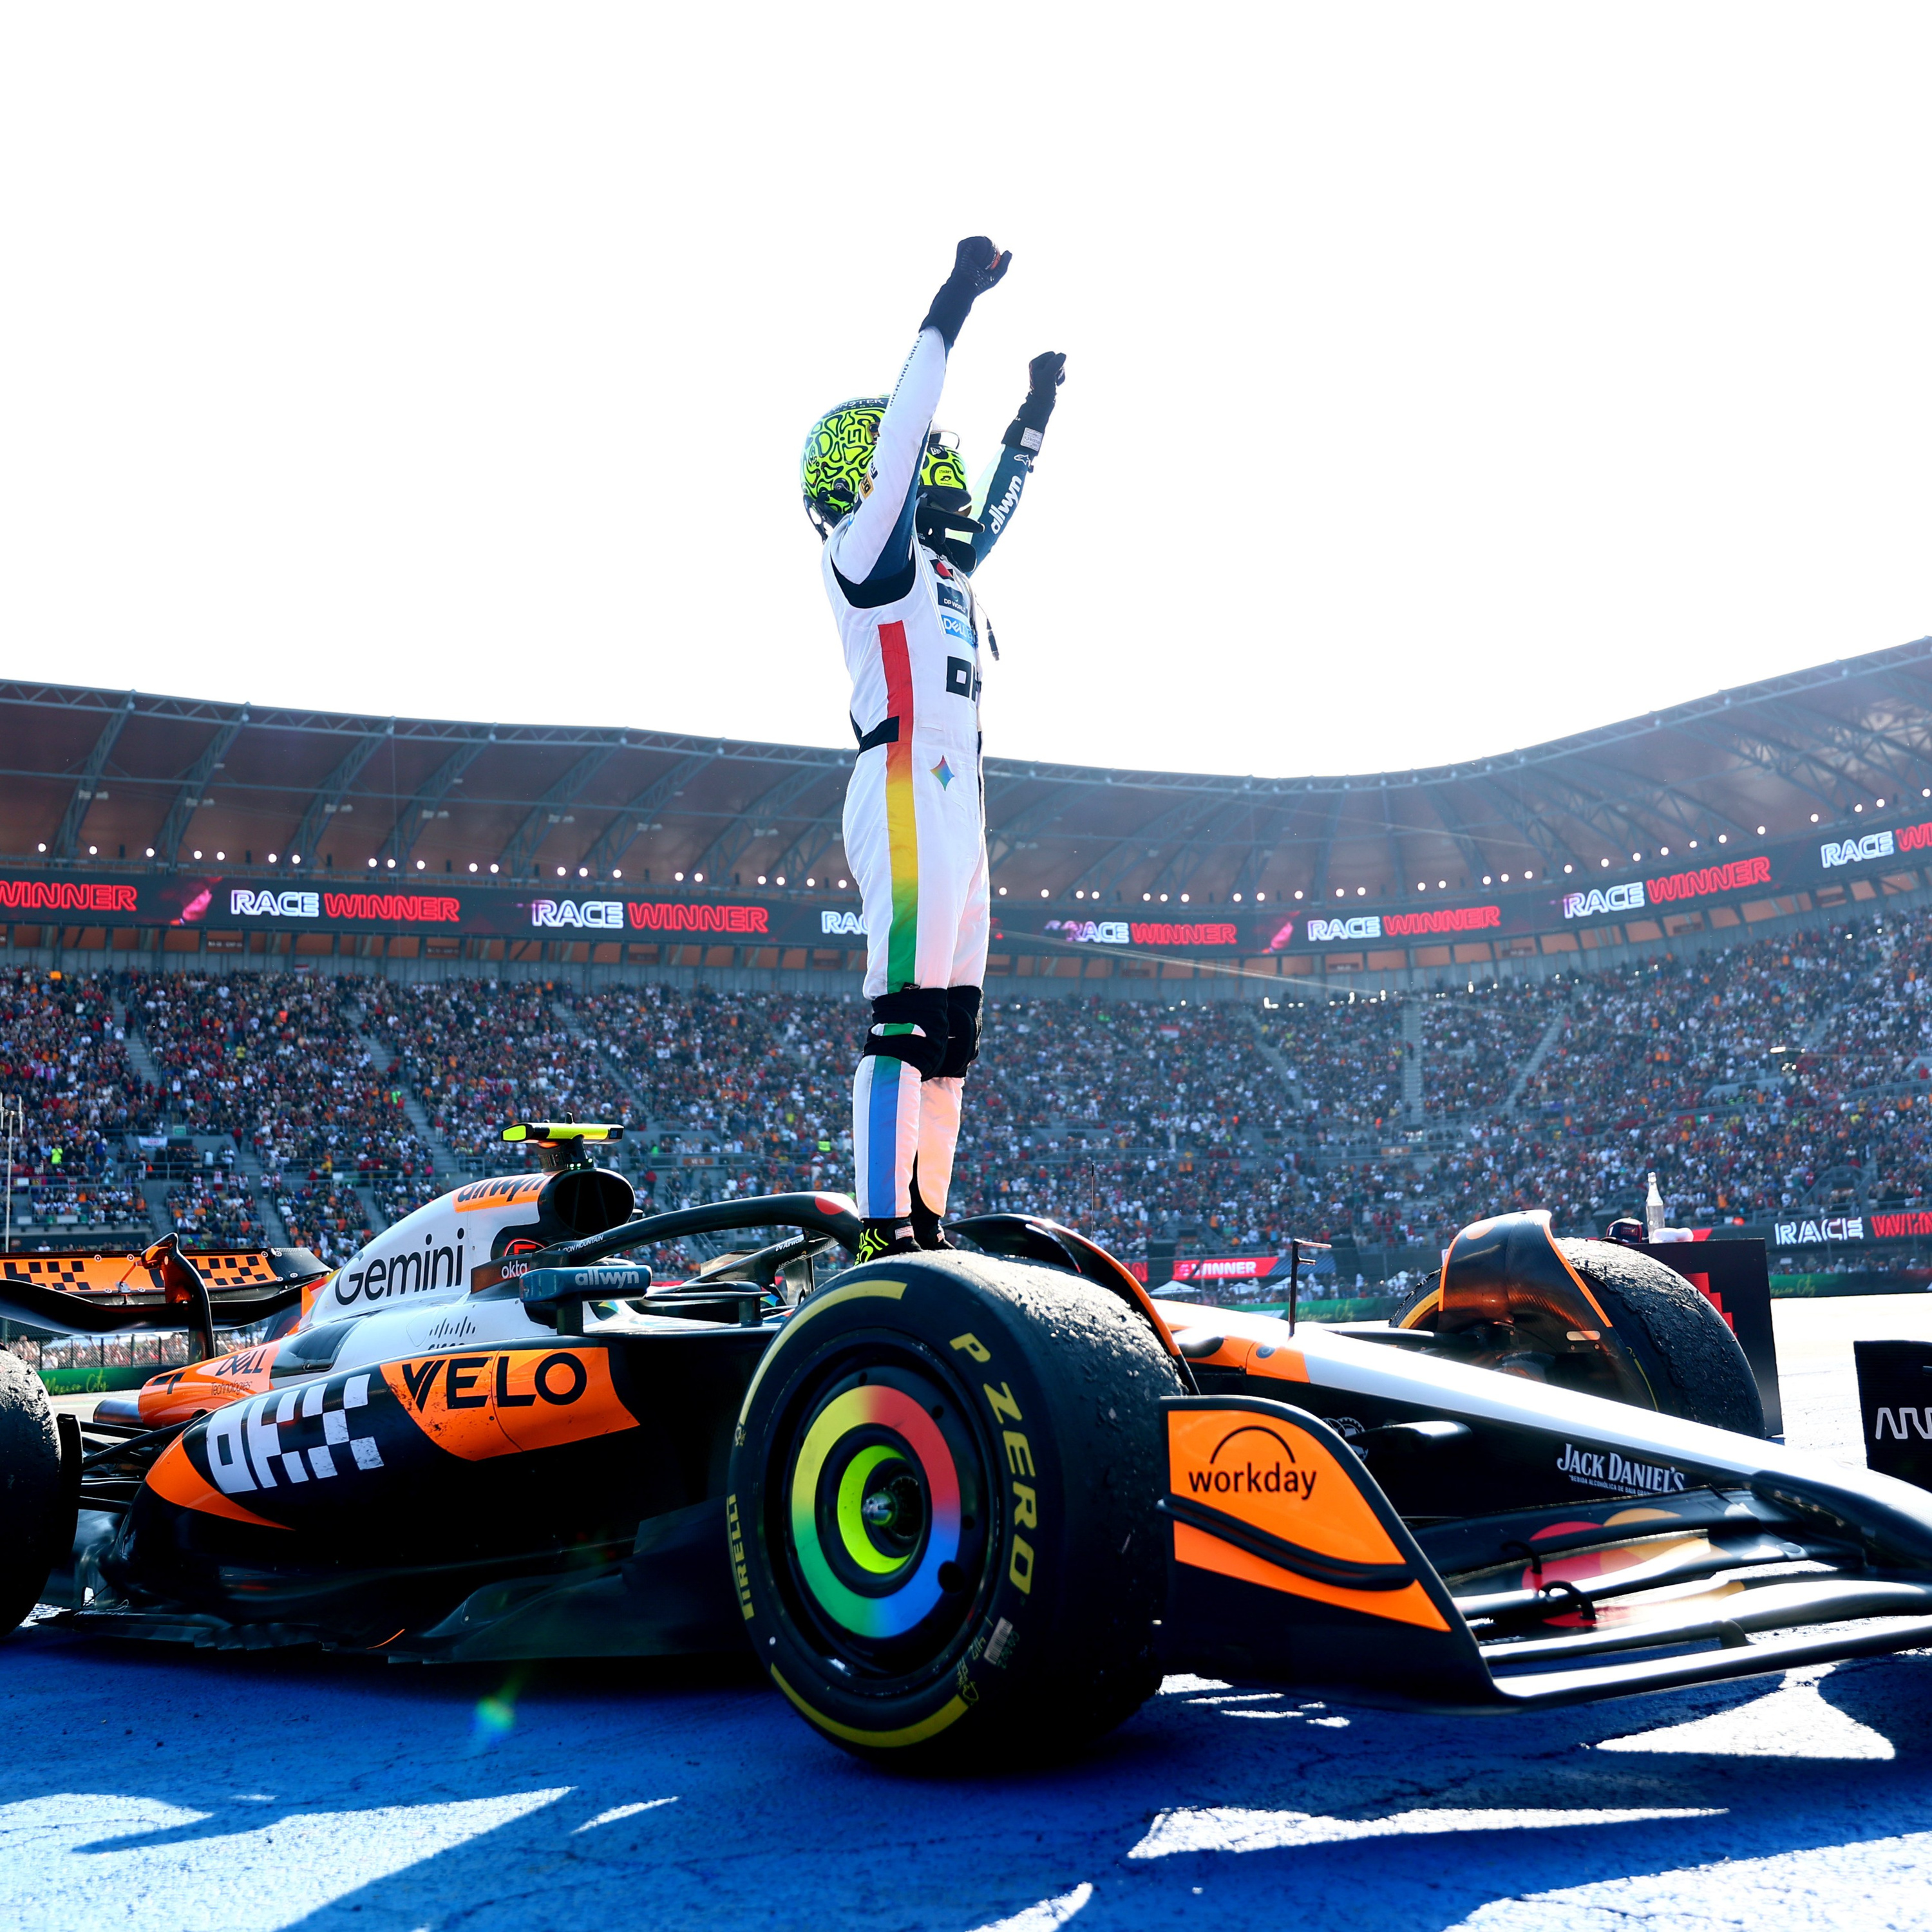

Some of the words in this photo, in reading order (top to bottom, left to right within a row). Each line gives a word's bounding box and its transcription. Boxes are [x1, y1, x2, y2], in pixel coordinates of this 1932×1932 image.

[989, 475, 1022, 535] allwyn
[952, 601, 967, 614] WORLD
[943, 617, 967, 638] DELL
[1821, 831, 1895, 868] RACE
[1564, 882, 1645, 919] RACE
[1646, 856, 1771, 904] WINNER
[231, 889, 319, 917] RACE
[324, 893, 460, 922] WINNER
[531, 900, 623, 929] RACE
[628, 902, 768, 933] WINNER
[1130, 923, 1236, 945] WINNER
[1307, 916, 1381, 941] RACE
[1383, 905, 1501, 936] WINNER
[457, 1176, 549, 1202] allwyn
[575, 1235, 604, 1250] MOUNTAIN
[1774, 1217, 1864, 1245] RACE
[335, 1227, 465, 1305] Gemini
[502, 1260, 528, 1279] okta
[575, 1269, 640, 1289] allwyn
[215, 1349, 267, 1376] DELL
[211, 1379, 253, 1396] Technologies
[402, 1352, 587, 1413] VELO
[949, 1332, 991, 1363] P
[983, 1381, 1037, 1595] ZERO
[1557, 1443, 1604, 1479] JACK
[1608, 1452, 1685, 1493] DANIEL'S
[1189, 1461, 1316, 1501] workday
[726, 1493, 755, 1620] PIRELLI
